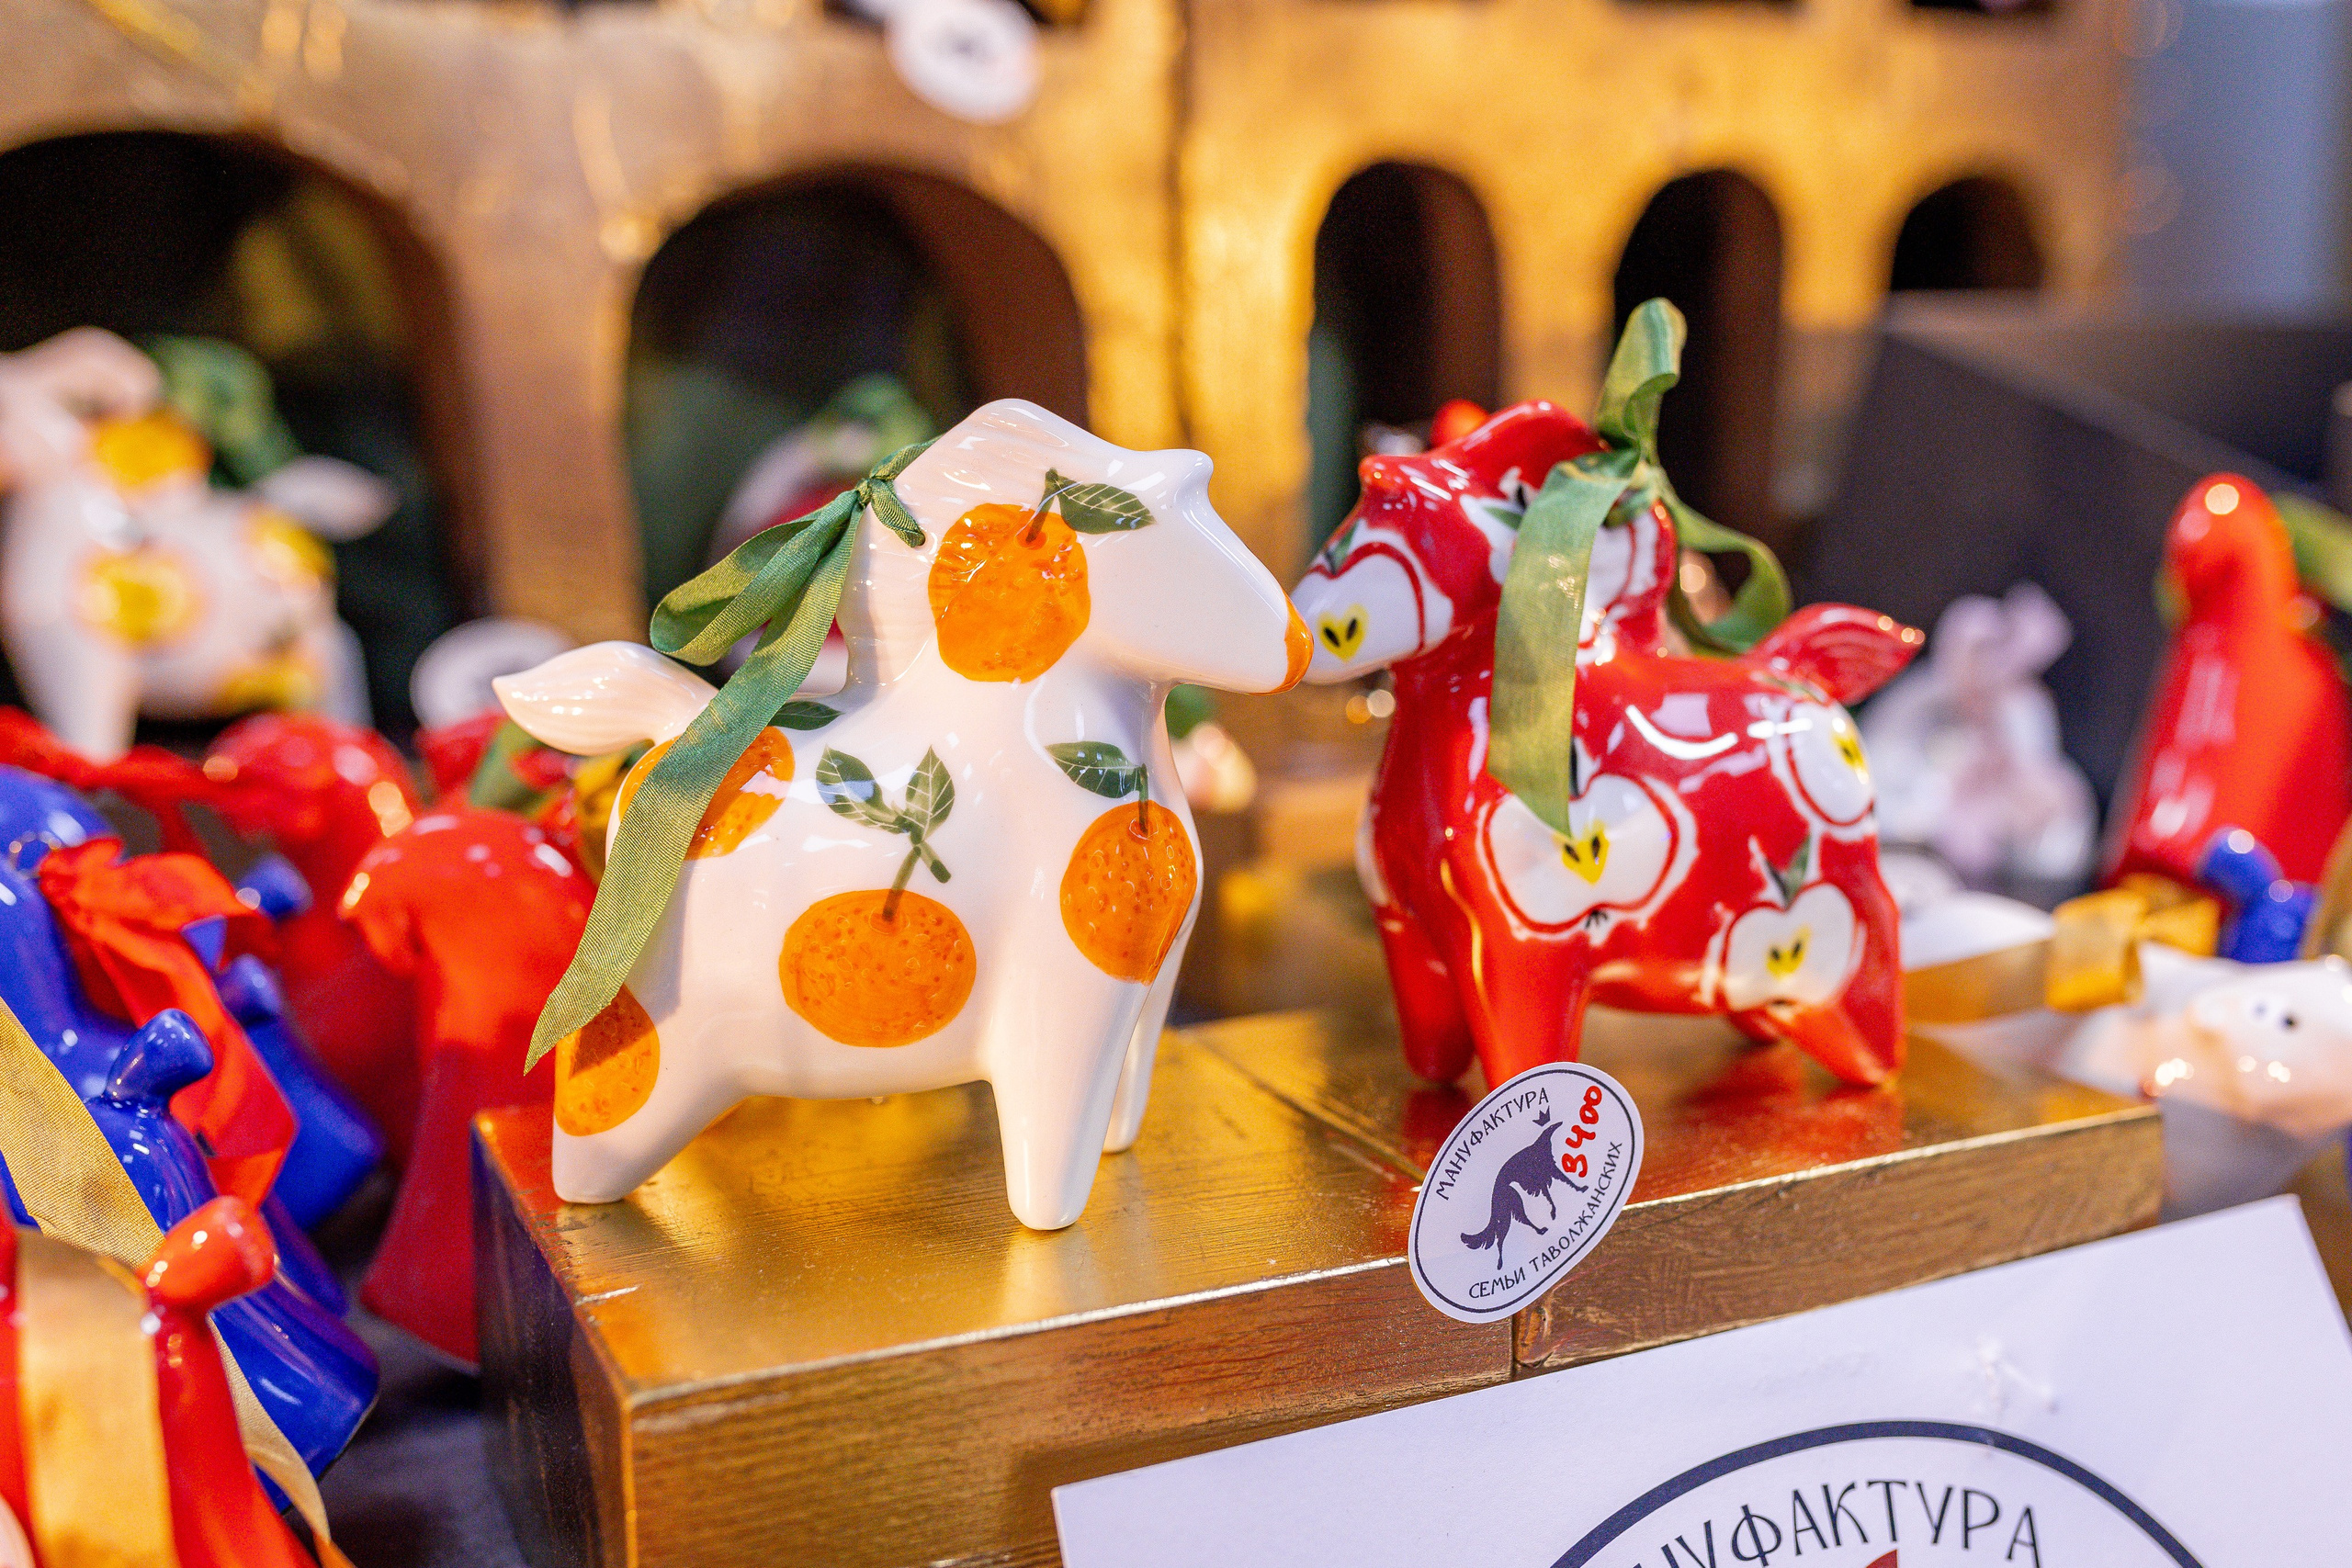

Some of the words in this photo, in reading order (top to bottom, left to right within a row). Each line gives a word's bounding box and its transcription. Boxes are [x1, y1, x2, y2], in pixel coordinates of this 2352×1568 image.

[1436, 1087, 1549, 1201] МАНУФАКТУРА
[1562, 1085, 1602, 1178] 3400
[1468, 1267, 1526, 1299] СЕМЬИ
[1529, 1141, 1623, 1271] ТАВОЛЖАНСКИХ
[1633, 1480, 2041, 1568] УФАКТУРА
